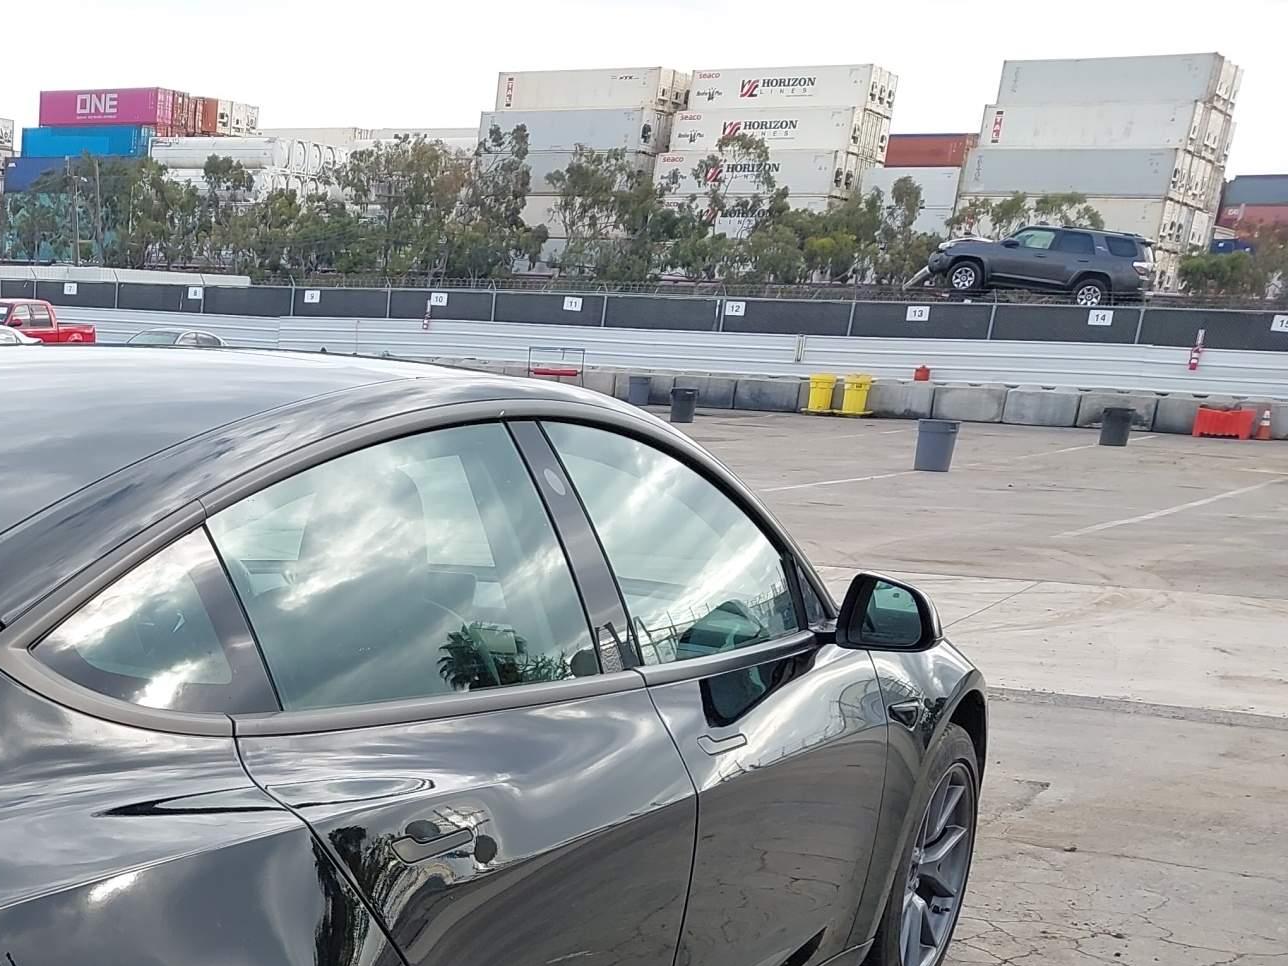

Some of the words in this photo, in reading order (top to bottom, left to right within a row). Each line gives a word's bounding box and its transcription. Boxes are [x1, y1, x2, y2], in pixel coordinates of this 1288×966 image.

[761, 77, 816, 88] HORIZON
[76, 93, 118, 114] ONE
[743, 120, 798, 130] HORIZON
[726, 162, 780, 173] HORIZON
[434, 295, 444, 303] 10
[731, 304, 741, 313] 12
[912, 310, 923, 318] 13
[1095, 313, 1106, 322] 14
